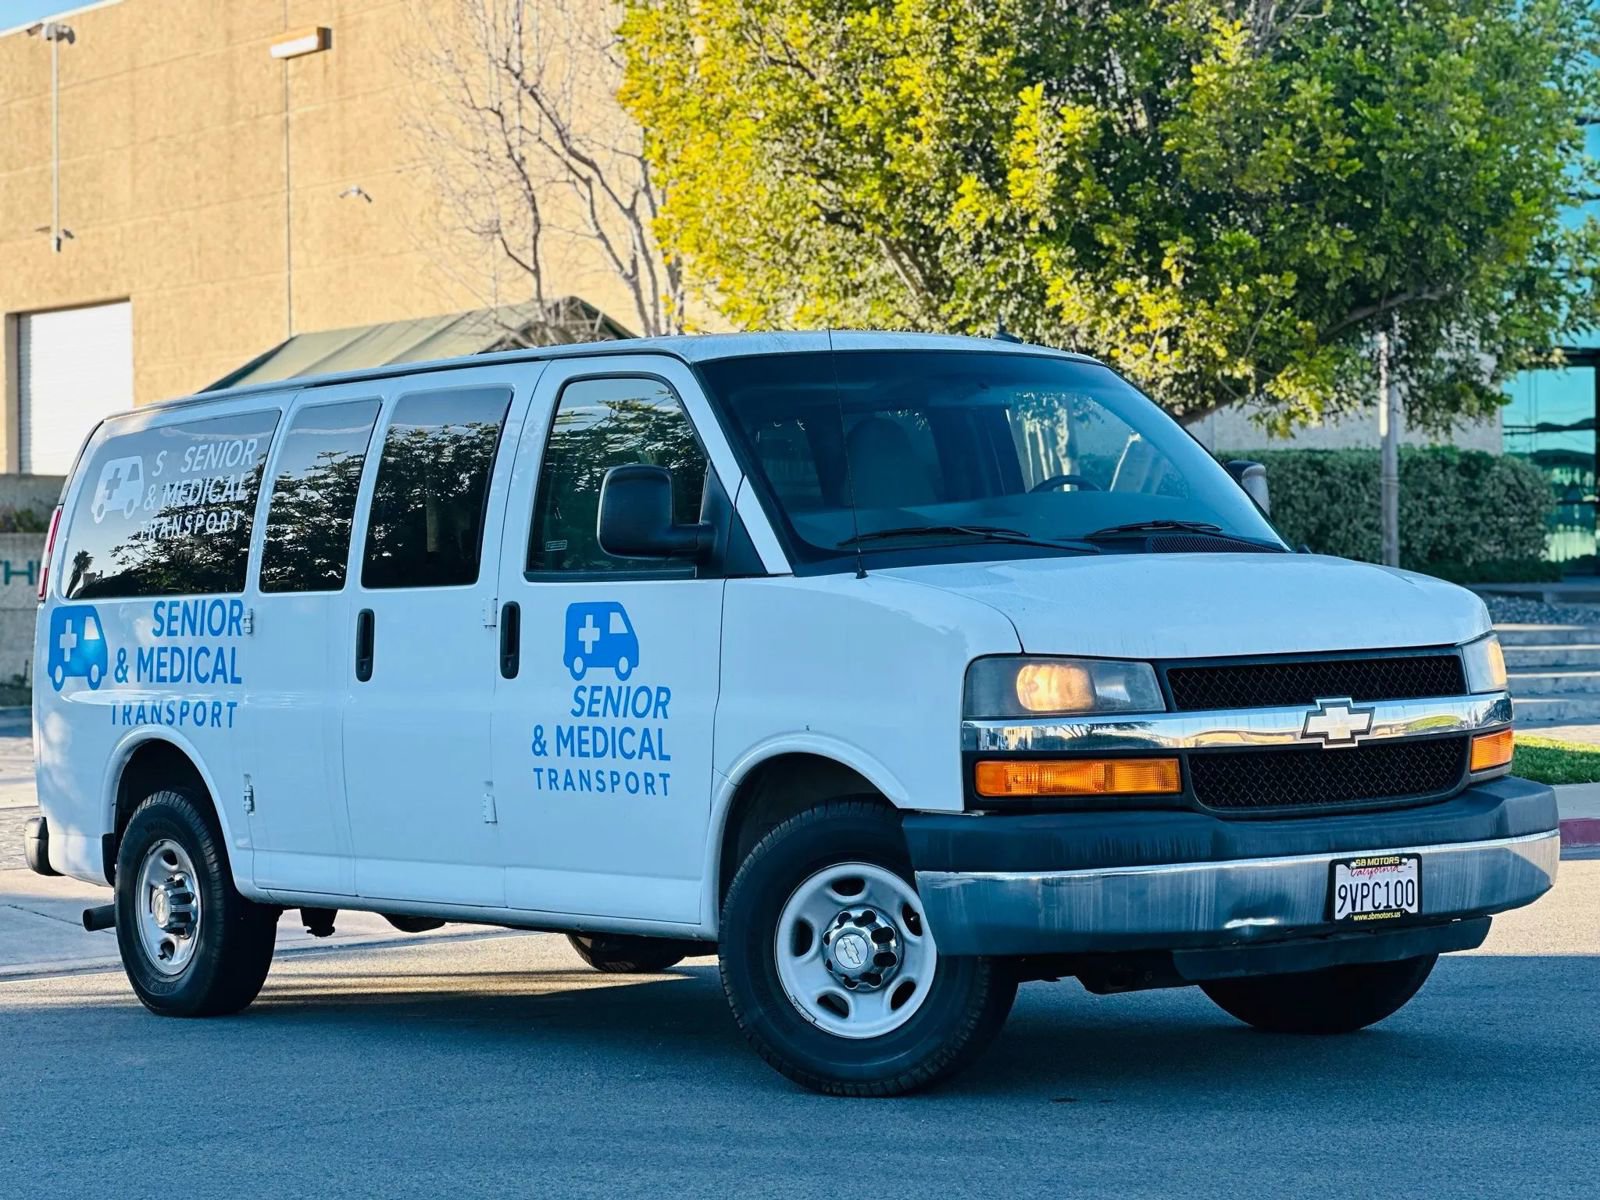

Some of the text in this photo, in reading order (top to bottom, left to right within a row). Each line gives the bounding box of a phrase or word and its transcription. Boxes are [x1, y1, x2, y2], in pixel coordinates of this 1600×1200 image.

[152, 438, 258, 477] S SENIOR
[143, 472, 248, 512] & MEDICAL
[139, 509, 242, 540] TRANSPORT
[151, 599, 243, 637] SENIOR
[114, 646, 242, 684] & MEDICAL
[110, 700, 238, 728] TRANSPORT
[570, 685, 671, 719] SENIOR
[531, 724, 671, 761] & MEDICAL
[533, 767, 671, 796] TRANSPORT
[1367, 856, 1399, 866] MOTORS
[1337, 879, 1415, 913] 9VPC100
[1353, 911, 1401, 921] www.sbmotors.us
